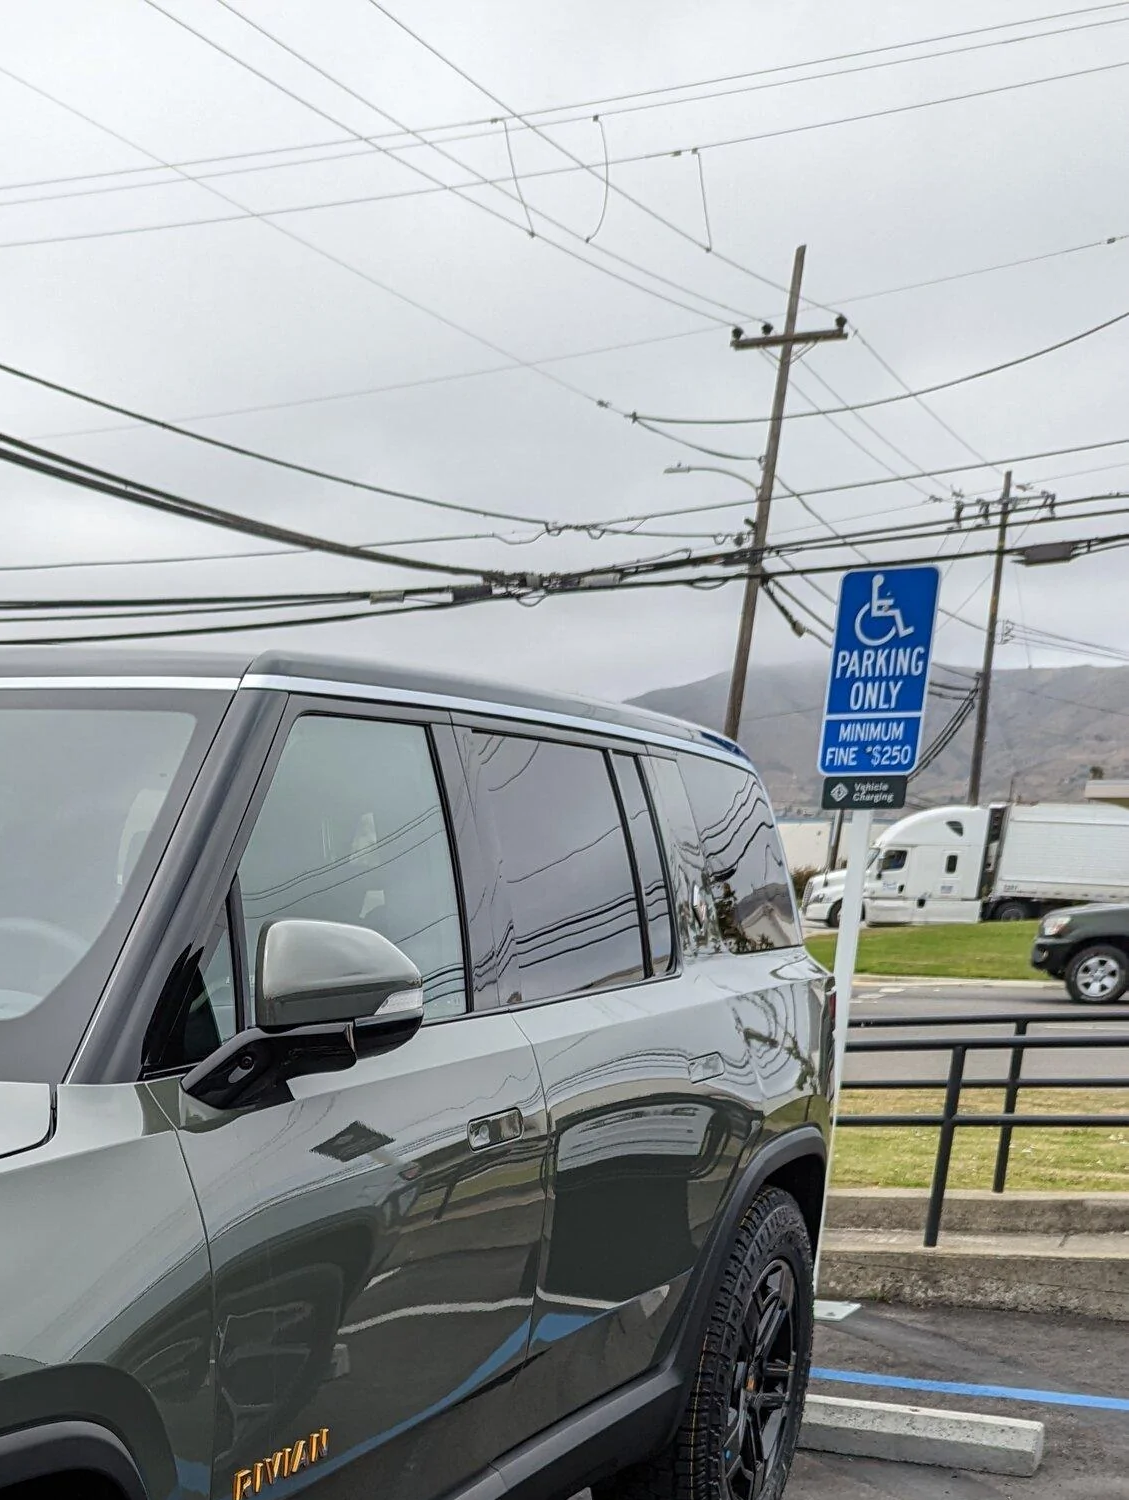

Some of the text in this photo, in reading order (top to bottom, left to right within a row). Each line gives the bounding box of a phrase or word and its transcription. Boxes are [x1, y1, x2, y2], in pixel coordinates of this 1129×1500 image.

[835, 646, 925, 679] PARKING
[849, 680, 903, 711] ONLY
[838, 721, 905, 743] MINIMUM
[825, 747, 859, 767] FINE
[853, 791, 894, 803] Charging
[854, 782, 889, 791] Vehicle
